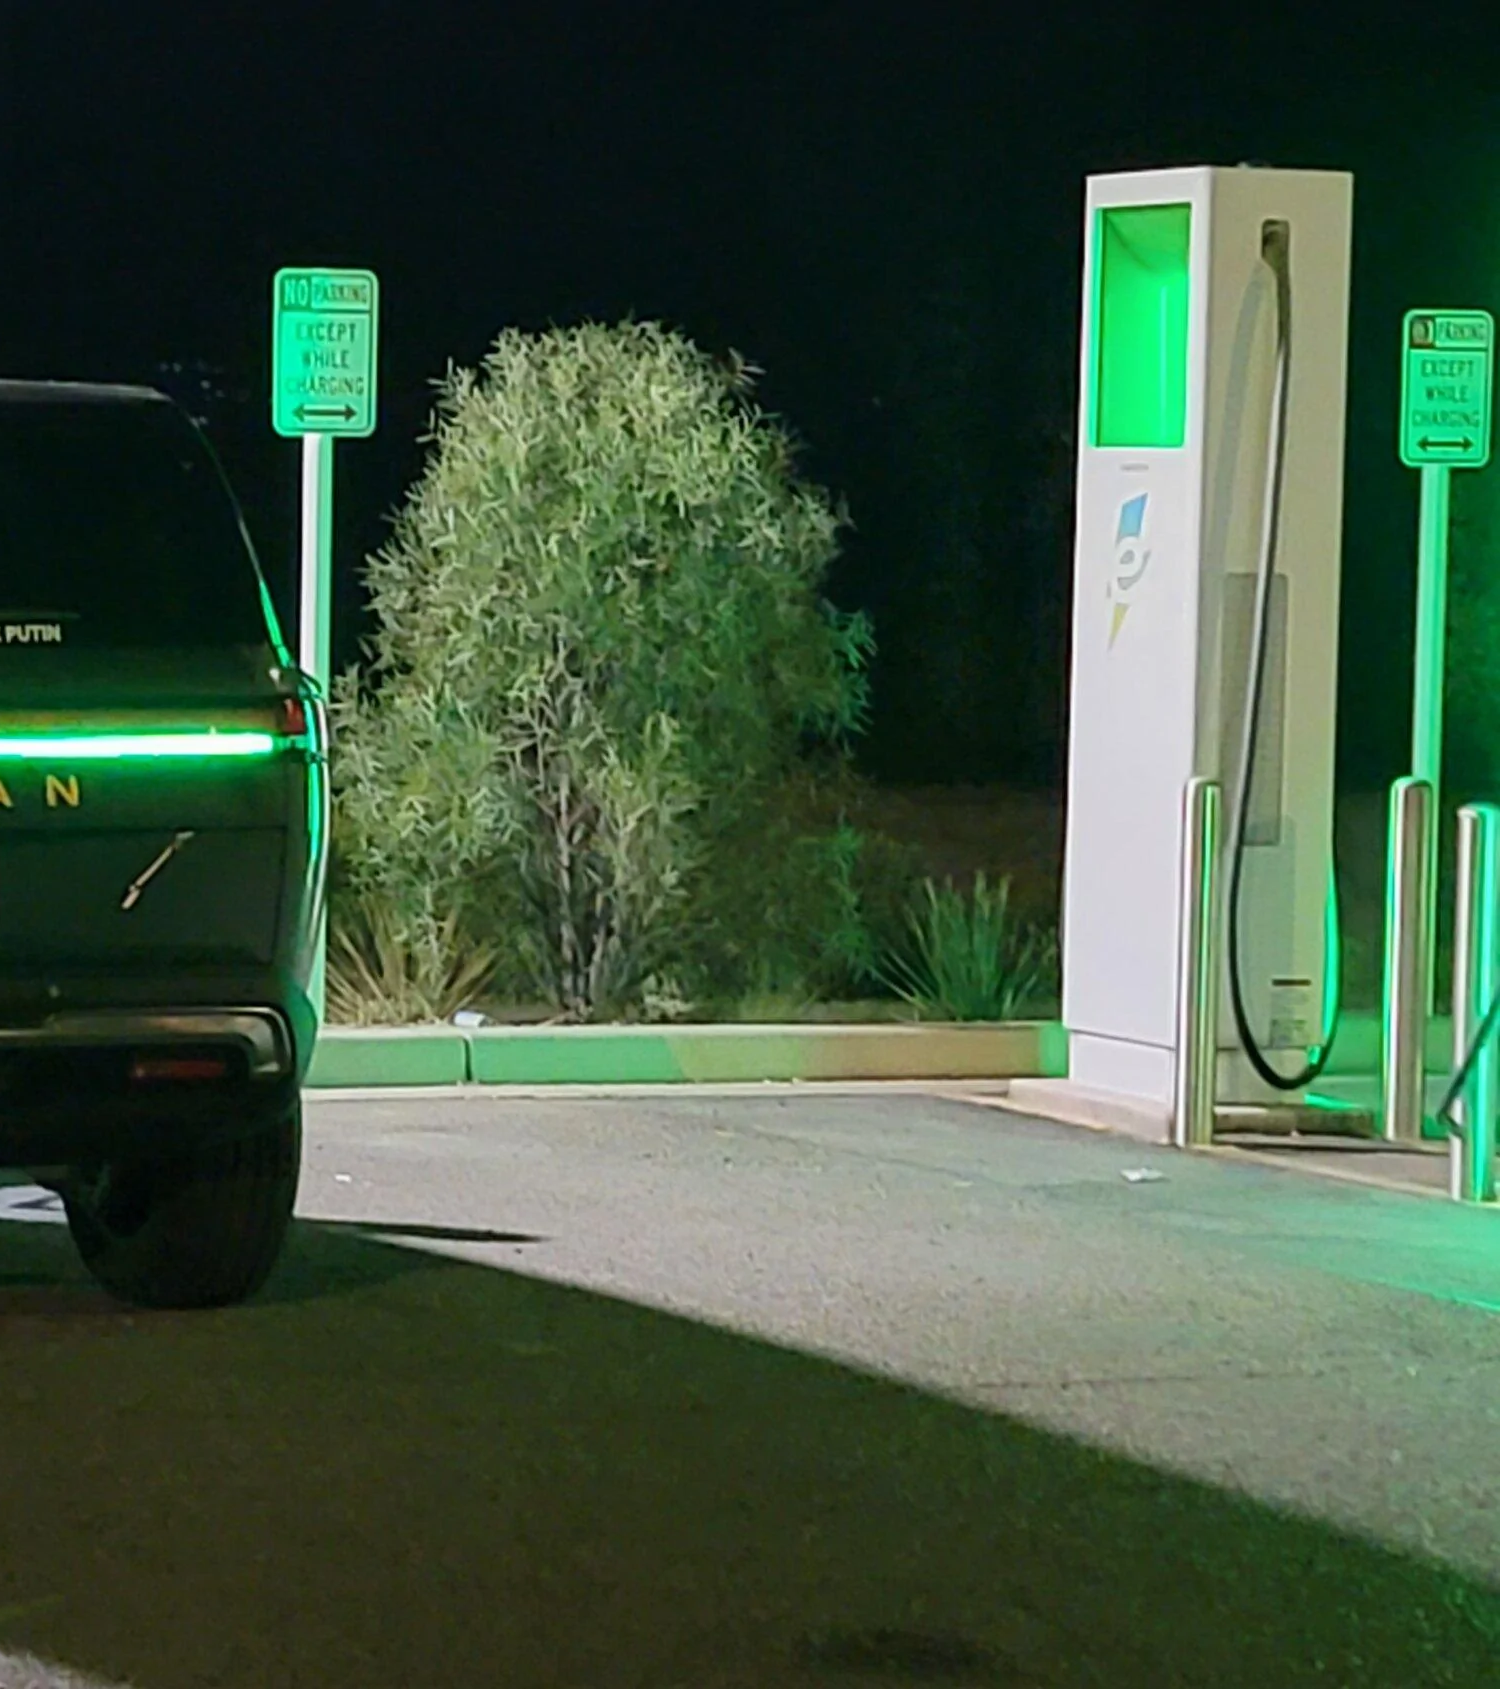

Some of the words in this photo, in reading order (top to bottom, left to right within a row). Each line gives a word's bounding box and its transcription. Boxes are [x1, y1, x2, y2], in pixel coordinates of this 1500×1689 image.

[283, 278, 309, 306] NO
[296, 322, 357, 343] EXCEPT
[302, 349, 351, 370] WHILE
[285, 375, 365, 397] CHARGING
[5, 623, 62, 644] PUTIN
